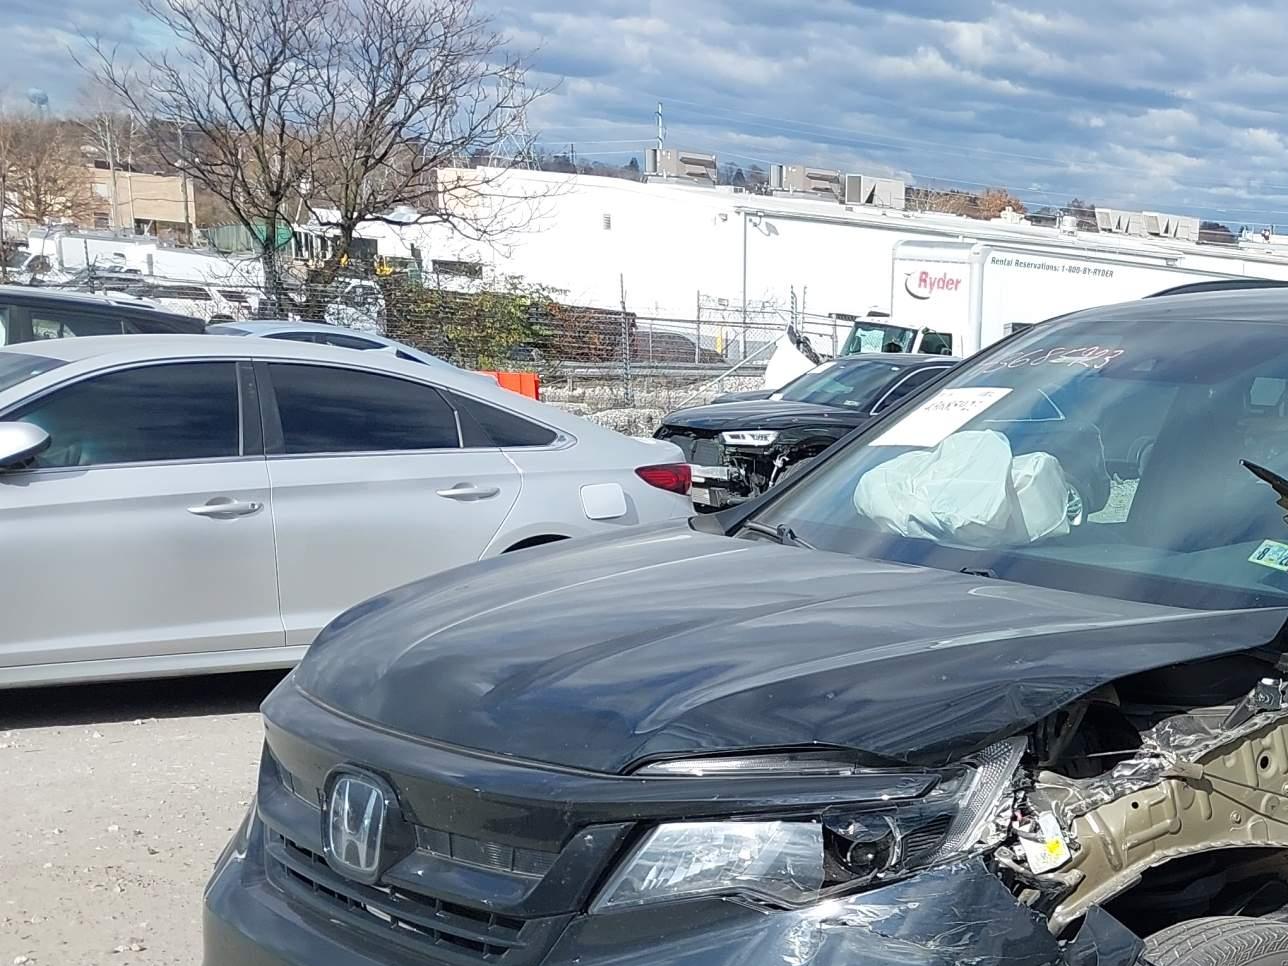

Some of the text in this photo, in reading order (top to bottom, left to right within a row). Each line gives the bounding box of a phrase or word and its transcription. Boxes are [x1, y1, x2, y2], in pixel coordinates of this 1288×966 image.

[990, 257, 1013, 267] Rental
[1014, 259, 1059, 272] Reservations:
[918, 270, 962, 293] Ryder
[1256, 547, 1271, 561] 8
